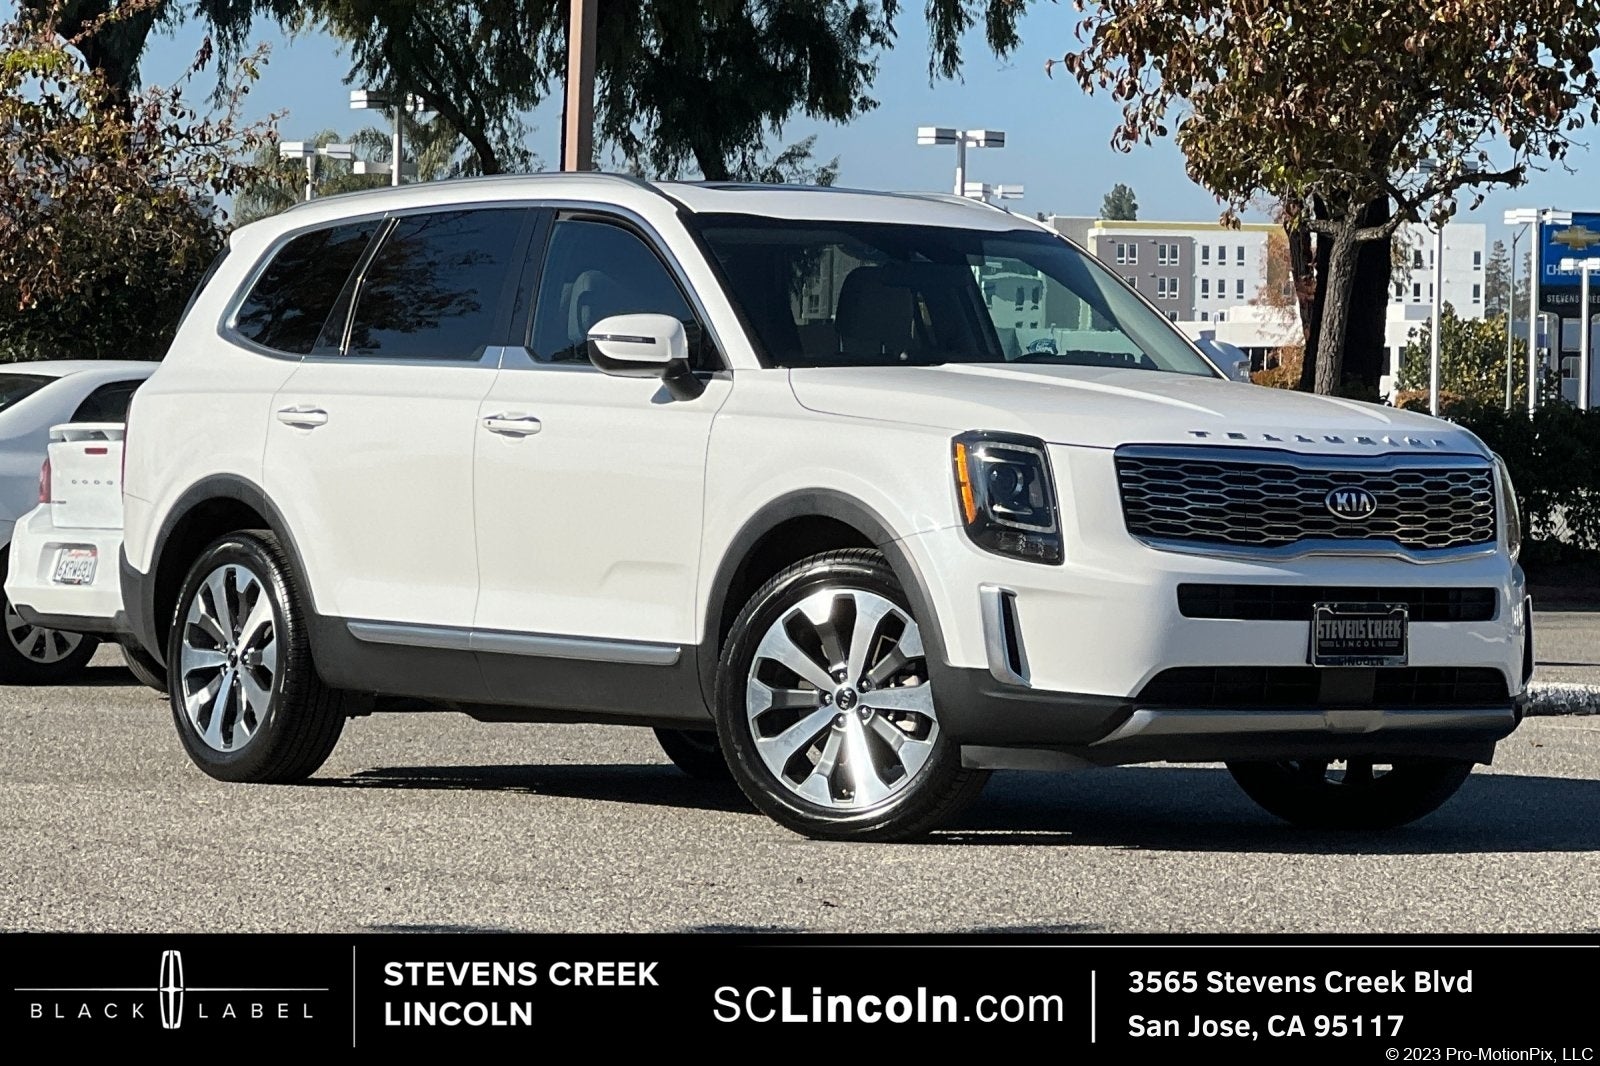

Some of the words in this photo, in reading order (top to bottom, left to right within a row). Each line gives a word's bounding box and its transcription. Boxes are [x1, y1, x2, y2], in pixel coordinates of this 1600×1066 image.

[1336, 491, 1372, 512] KIA
[1318, 619, 1366, 639] STEVENS
[1367, 619, 1402, 639] CREEK
[1335, 640, 1385, 648] LINCOLN
